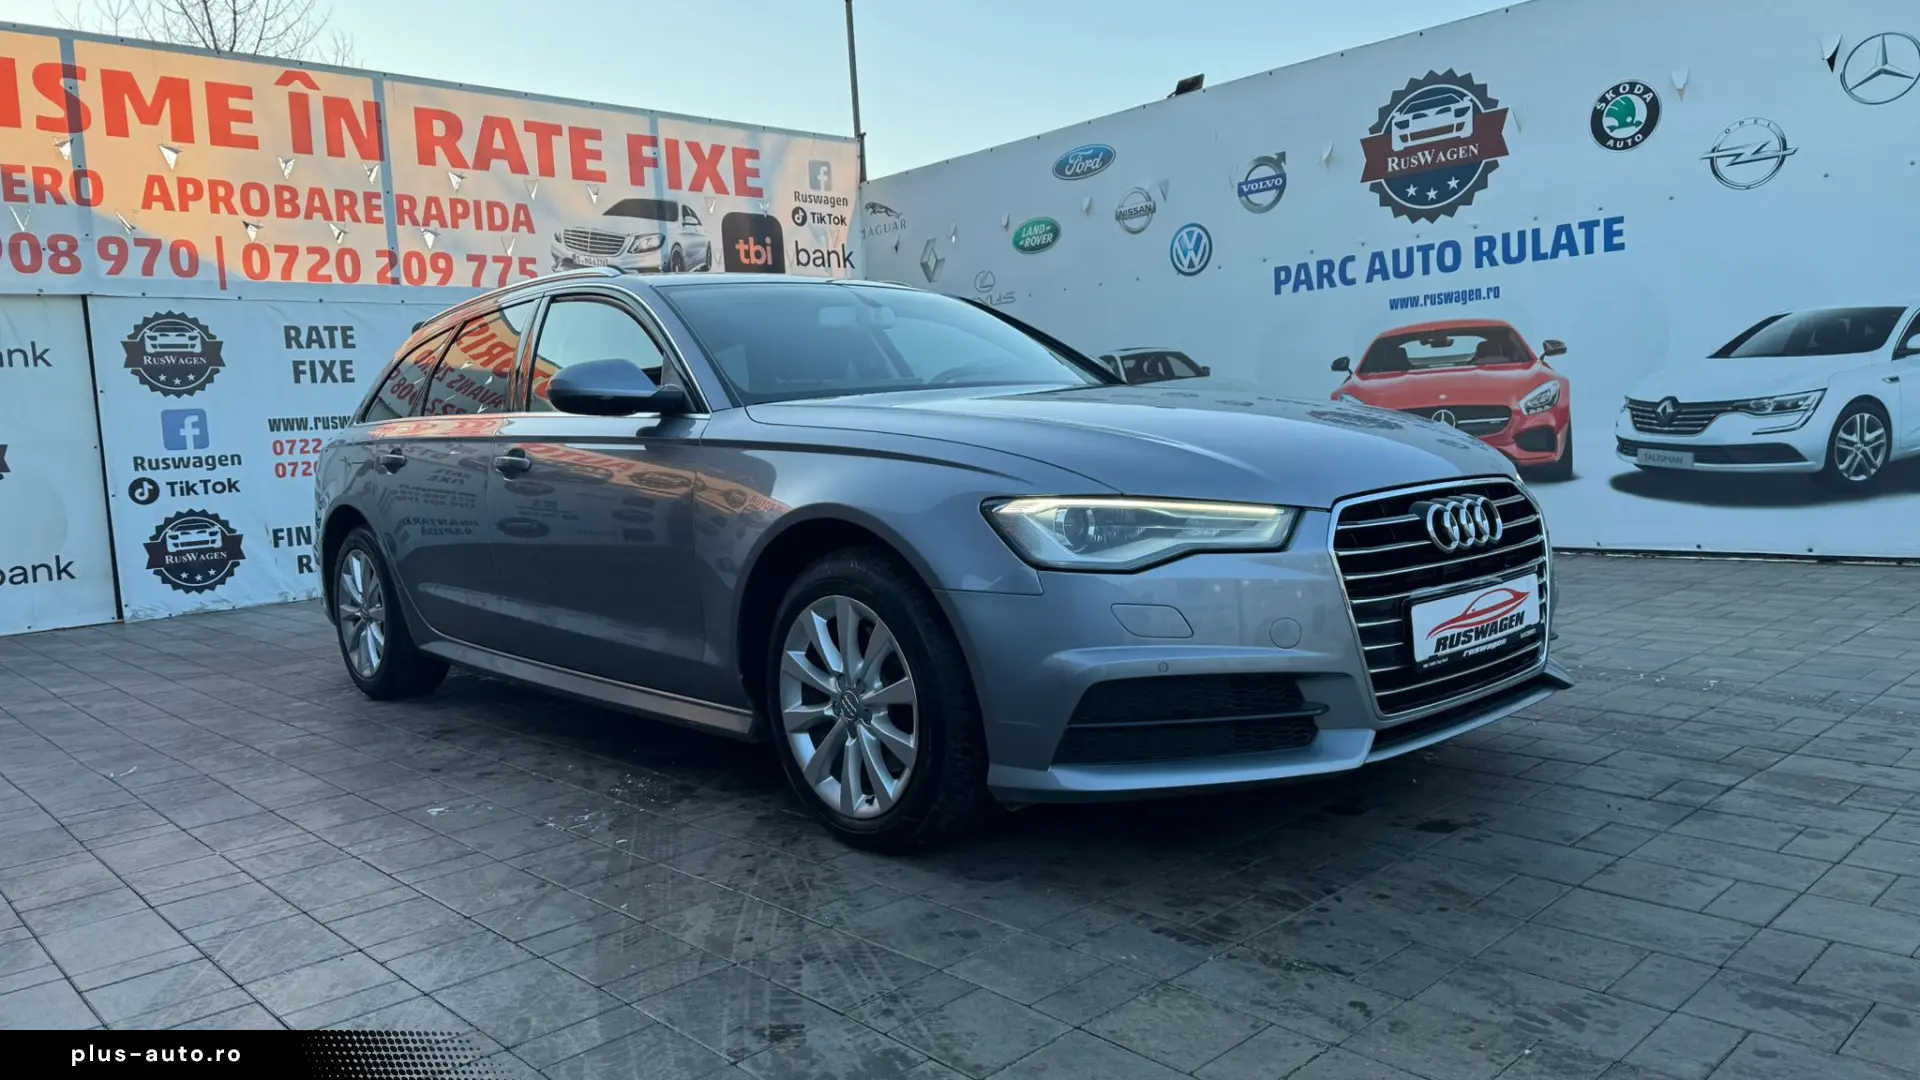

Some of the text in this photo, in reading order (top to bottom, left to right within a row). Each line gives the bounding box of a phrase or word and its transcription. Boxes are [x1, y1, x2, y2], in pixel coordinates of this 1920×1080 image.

[273, 70, 386, 162] ÎN
[413, 106, 607, 183] RATE
[626, 133, 764, 199] FIXE
[1723, 118, 1774, 135] OPEL
[1606, 133, 1643, 149] AUTO
[1065, 149, 1104, 176] Ford
[1241, 178, 1283, 193] VOLVO
[0, 163, 537, 235] ERO APROBARE RAPIDA
[793, 190, 849, 208] Ruswagen
[1119, 203, 1153, 218] NISSAN
[810, 211, 848, 227] TikTok
[1021, 223, 1046, 238] LAND
[735, 236, 773, 266] tbi
[1023, 232, 1054, 249] ROVER
[0, 231, 82, 275] 08
[97, 235, 200, 279] 970
[242, 242, 362, 285] 0720
[375, 248, 454, 287] 209
[466, 253, 540, 288] 775
[795, 240, 856, 269] bank
[1274, 216, 1626, 295] PARC AUTO RULATE
[1389, 285, 1501, 311] www.ruswagen.ro
[283, 325, 357, 350] RATE
[0, 341, 53, 368] nk
[292, 359, 356, 384] FIXE
[272, 438, 323, 456] 0722
[132, 452, 243, 473] Ruswagen
[275, 460, 318, 478] 072
[166, 477, 242, 498] TikTok
[1434, 611, 1526, 653] RUSWAGEN
